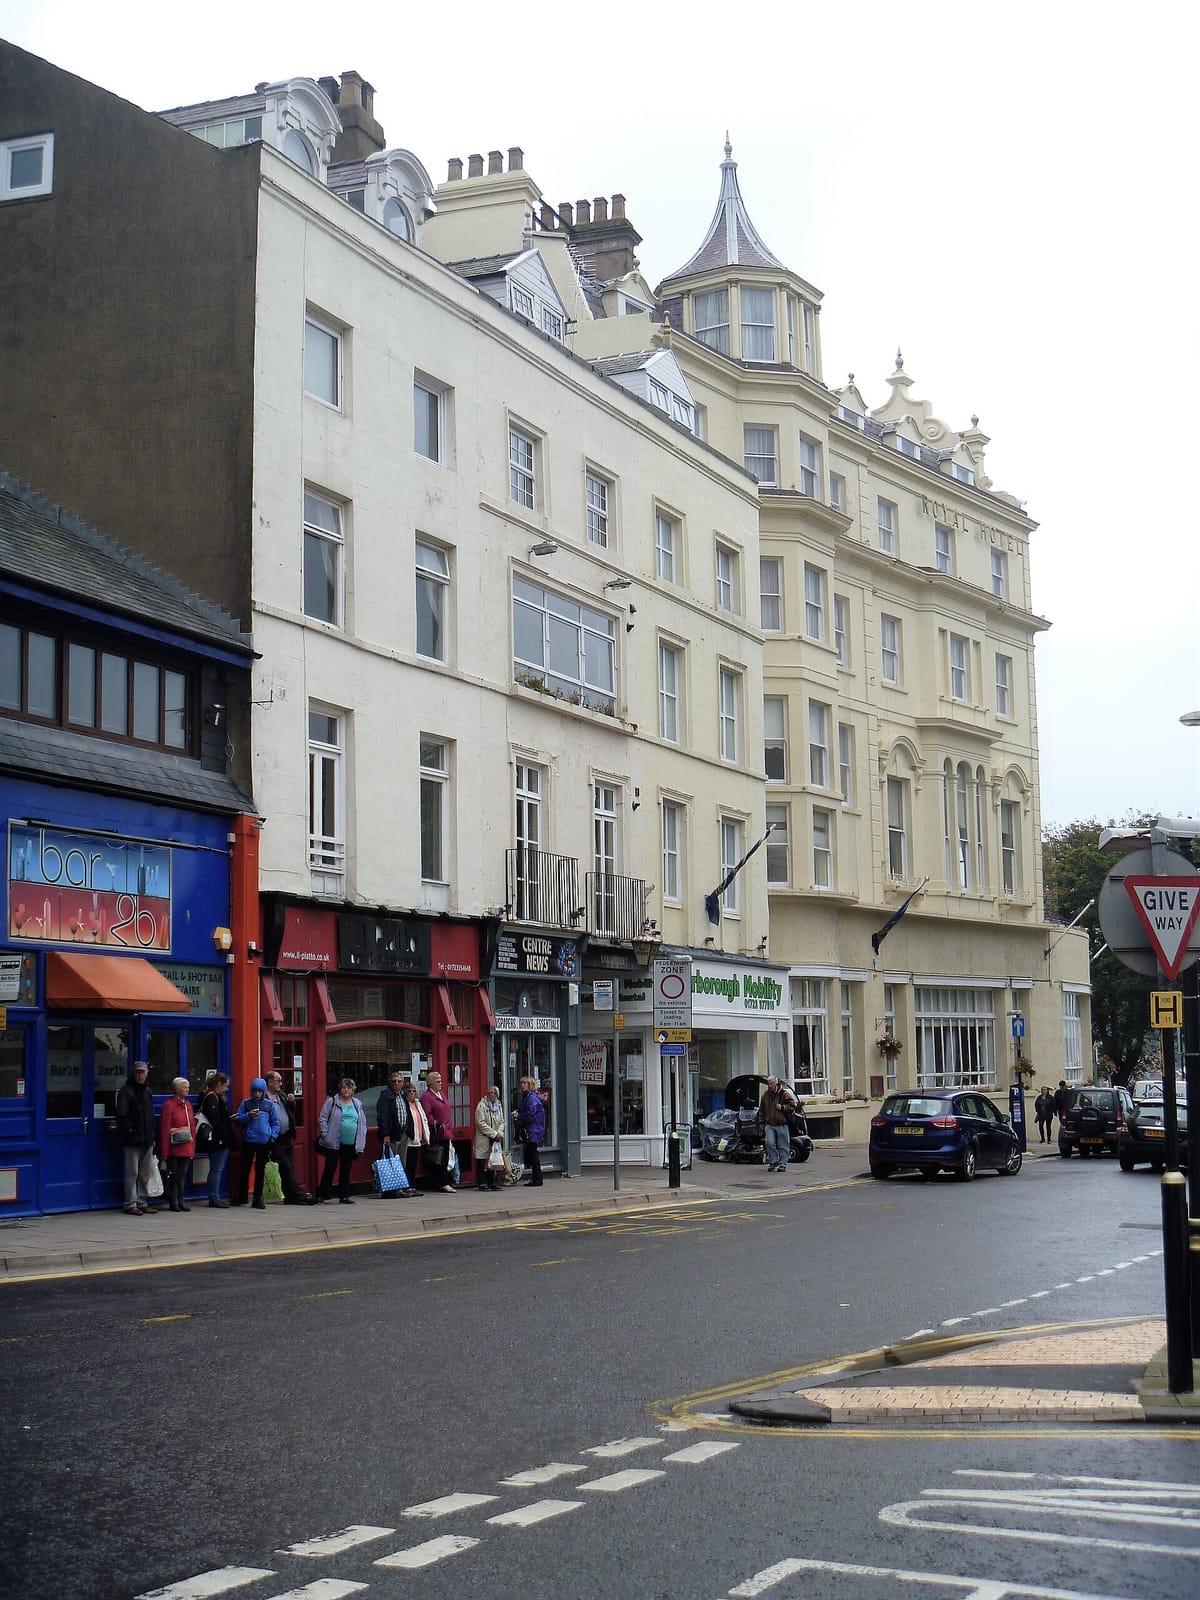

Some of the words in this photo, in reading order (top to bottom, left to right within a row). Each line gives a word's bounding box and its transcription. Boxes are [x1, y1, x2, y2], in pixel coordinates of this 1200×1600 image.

[921, 494, 969, 533] ROYAL
[980, 525, 1025, 557] HOTEL
[40, 827, 101, 889] bar
[1143, 890, 1189, 911] GIVE
[1155, 916, 1183, 930] WAY
[522, 936, 552, 955] CENTRE
[526, 954, 549, 972] NEWS
[660, 966, 684, 974] ZONE
[187, 971, 207, 982] SHOT
[691, 969, 740, 1003] rborough
[743, 974, 783, 1007] Mobility
[522, 997, 527, 1008] 5
[1154, 995, 1178, 1025] H
[496, 1018, 516, 1030] SPAPERS
[536, 1018, 560, 1031] ESSENTIALS
[579, 1041, 604, 1057] heelchair
[581, 1056, 603, 1070] Scooter
